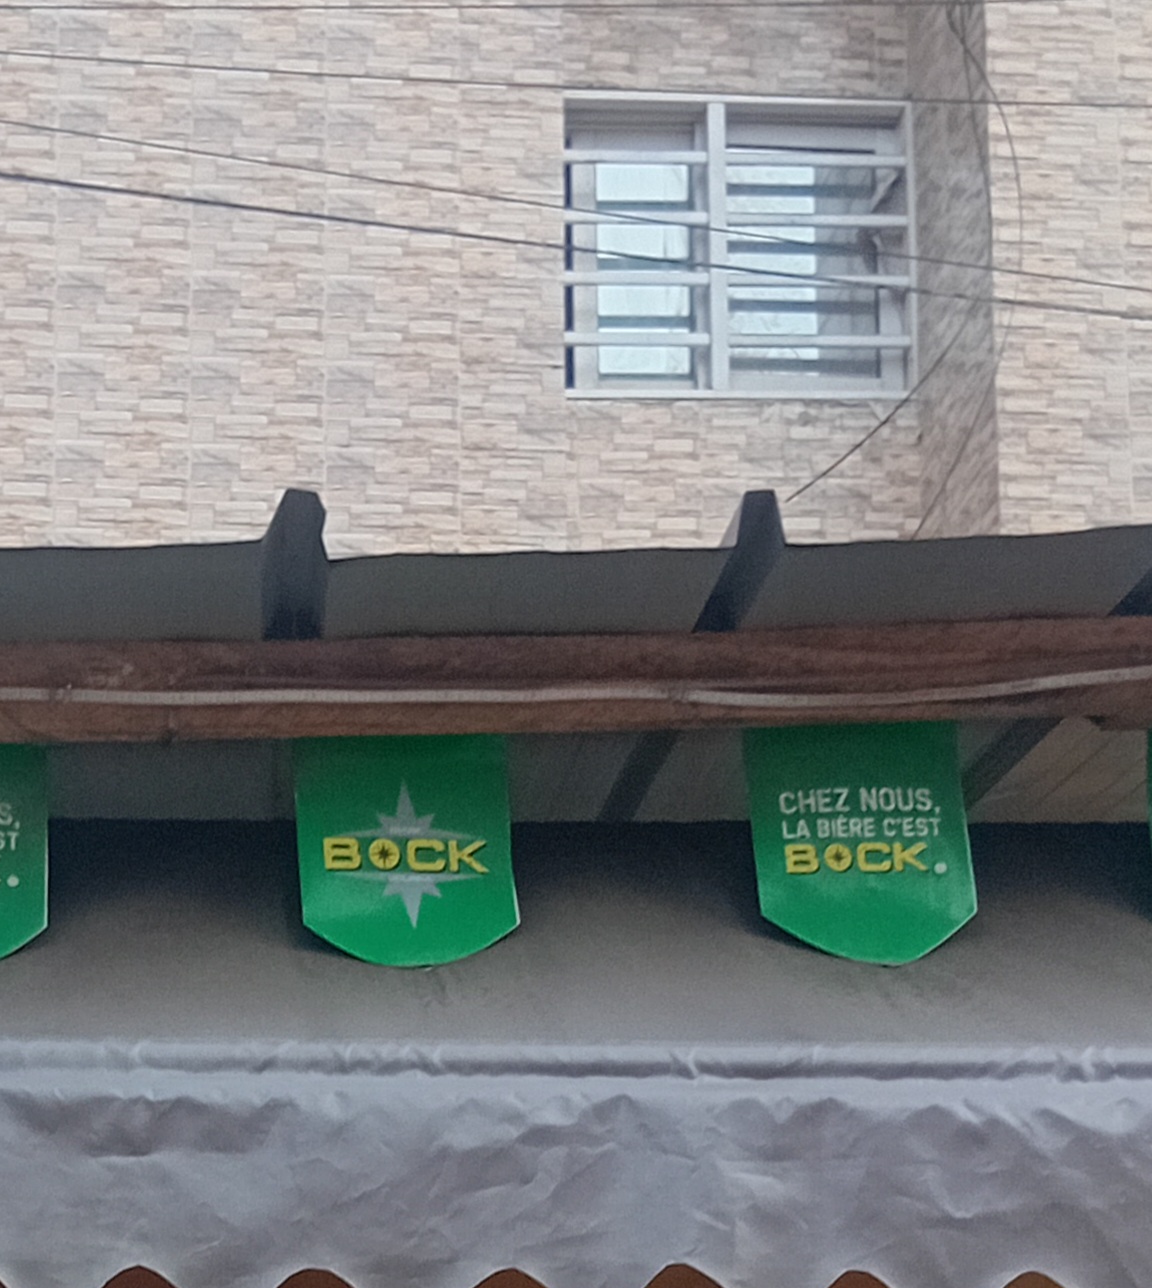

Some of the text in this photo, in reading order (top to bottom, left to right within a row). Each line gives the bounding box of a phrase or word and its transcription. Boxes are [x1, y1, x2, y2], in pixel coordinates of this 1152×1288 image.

[779, 786, 941, 816] CHEZ NOUS,
[782, 814, 942, 840] LA BIÈRE C'EST
[323, 836, 490, 874] BOCK
